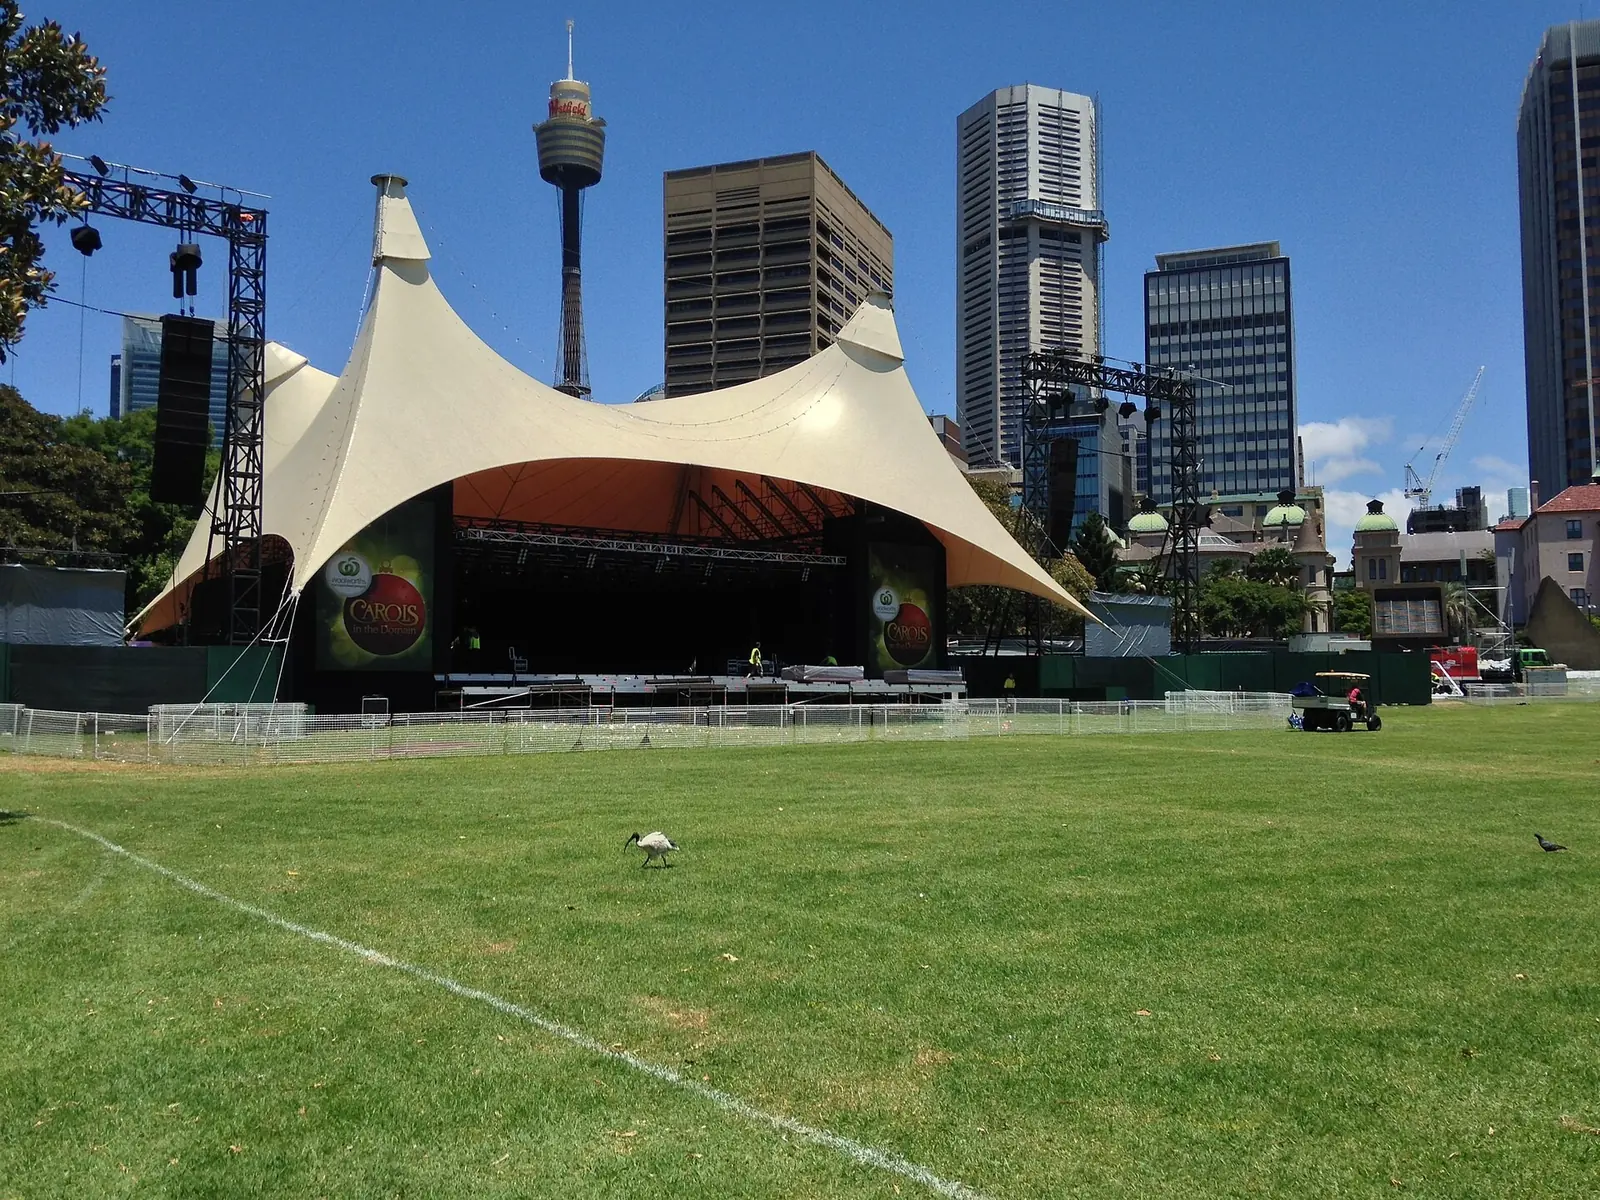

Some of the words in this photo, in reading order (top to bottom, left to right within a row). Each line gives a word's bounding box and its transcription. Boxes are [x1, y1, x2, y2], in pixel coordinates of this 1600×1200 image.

[349, 599, 419, 626] CAROLS
[353, 625, 361, 633] in
[364, 625, 378, 634] the
[381, 625, 417, 635] Domain
[887, 622, 928, 643] CAROLS
